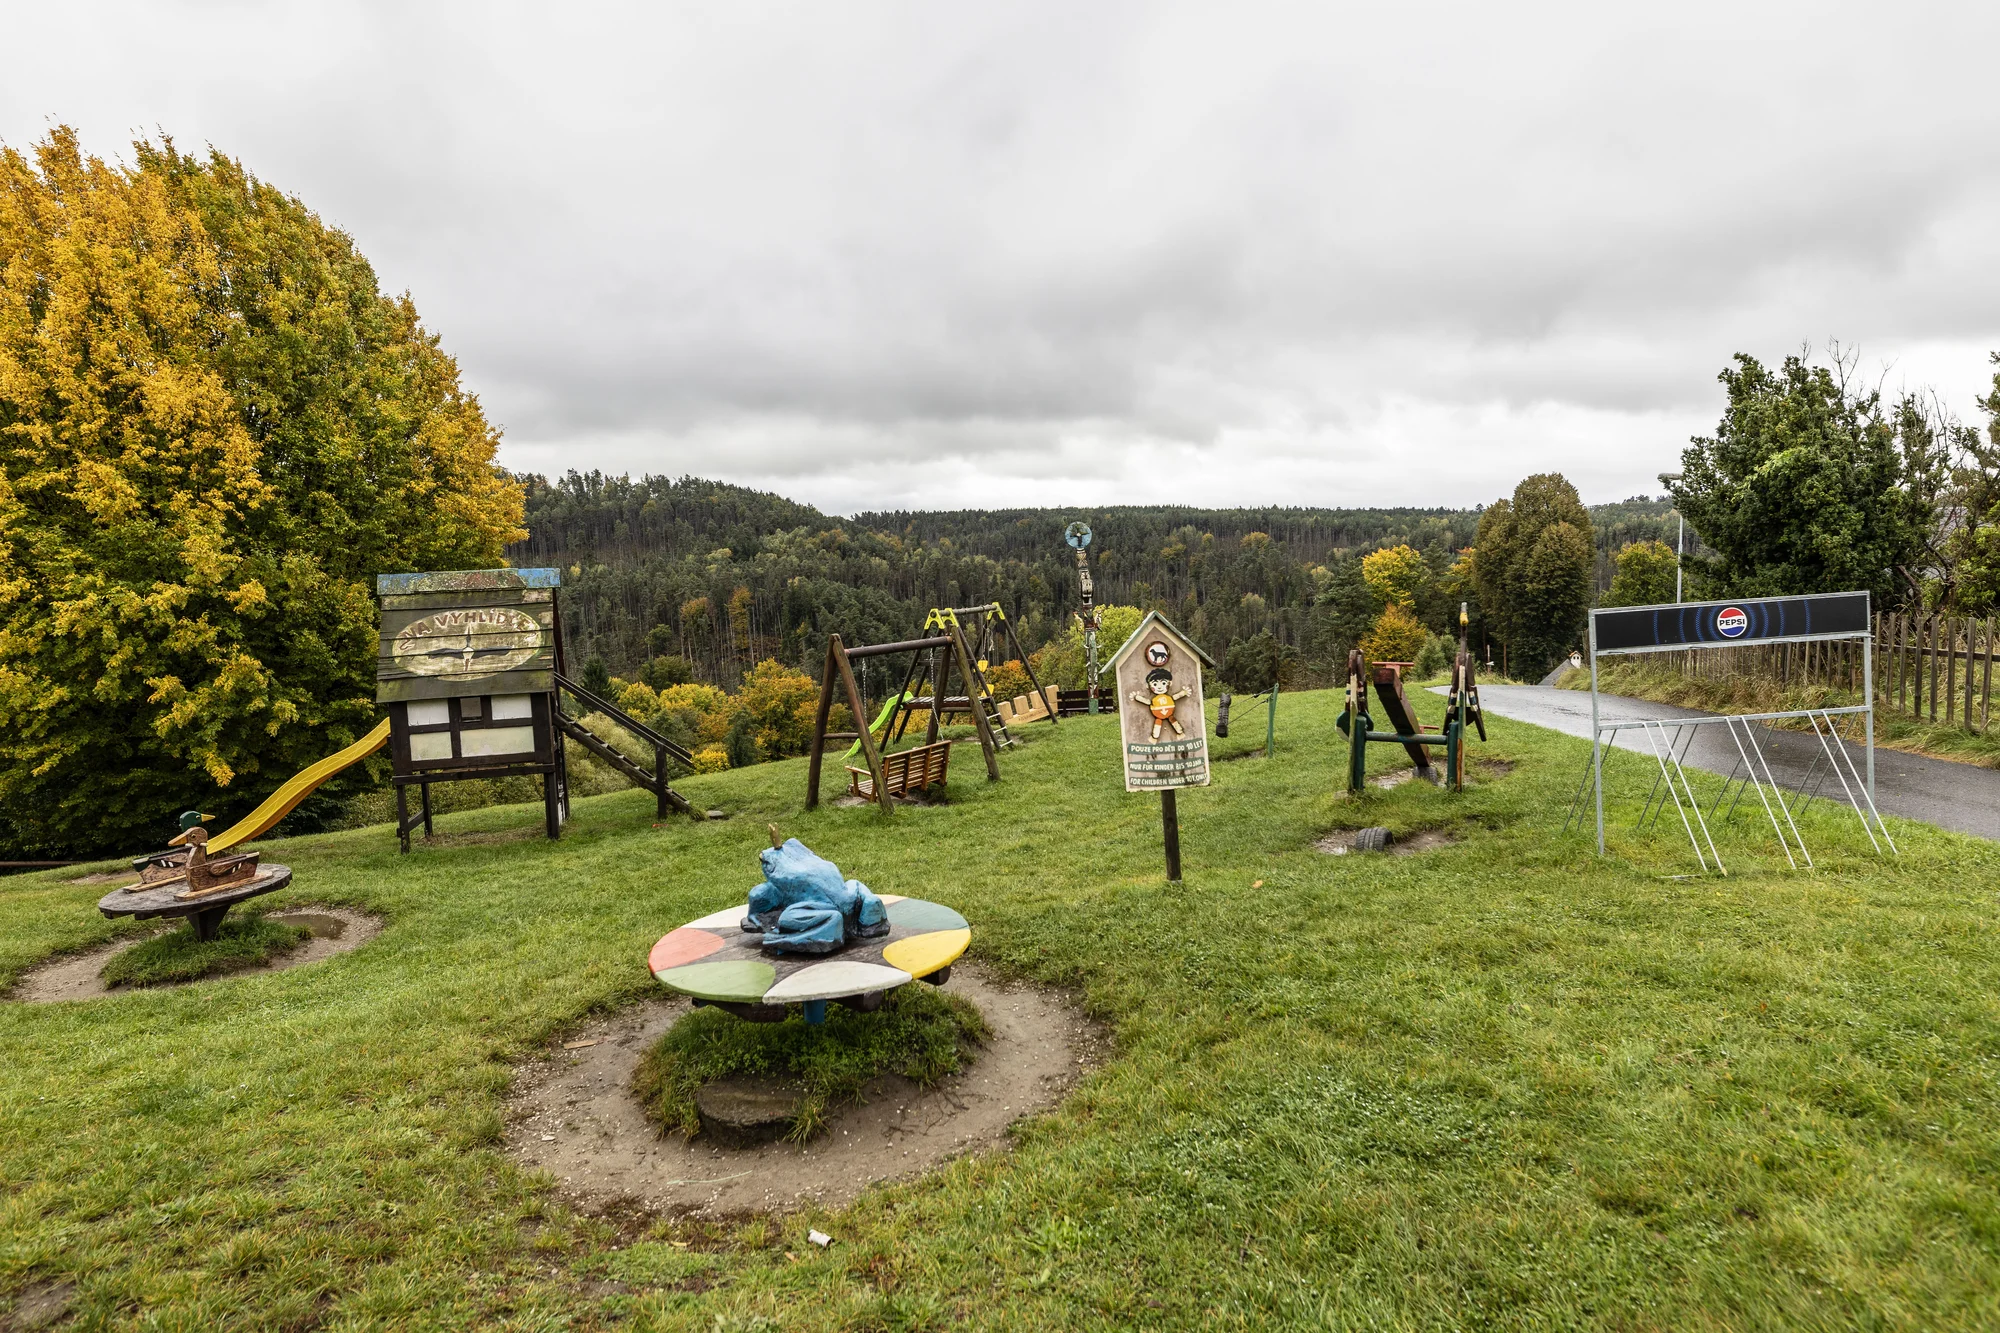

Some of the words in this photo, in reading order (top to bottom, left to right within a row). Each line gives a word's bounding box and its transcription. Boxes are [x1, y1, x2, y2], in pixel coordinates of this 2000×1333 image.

[1719, 618, 1746, 627] PEPSI
[1157, 696, 1168, 706] 10
[1131, 745, 1151, 753] POUZE
[1164, 744, 1176, 752] DĚTI
[1186, 742, 1194, 750] 10
[1193, 740, 1203, 749] LET
[1142, 761, 1154, 770] FÜR
[1154, 763, 1175, 771] KINDER
[1130, 777, 1141, 785] FOR
[1141, 778, 1167, 786] CHILDREN
[1168, 777, 1186, 785] UNDER
